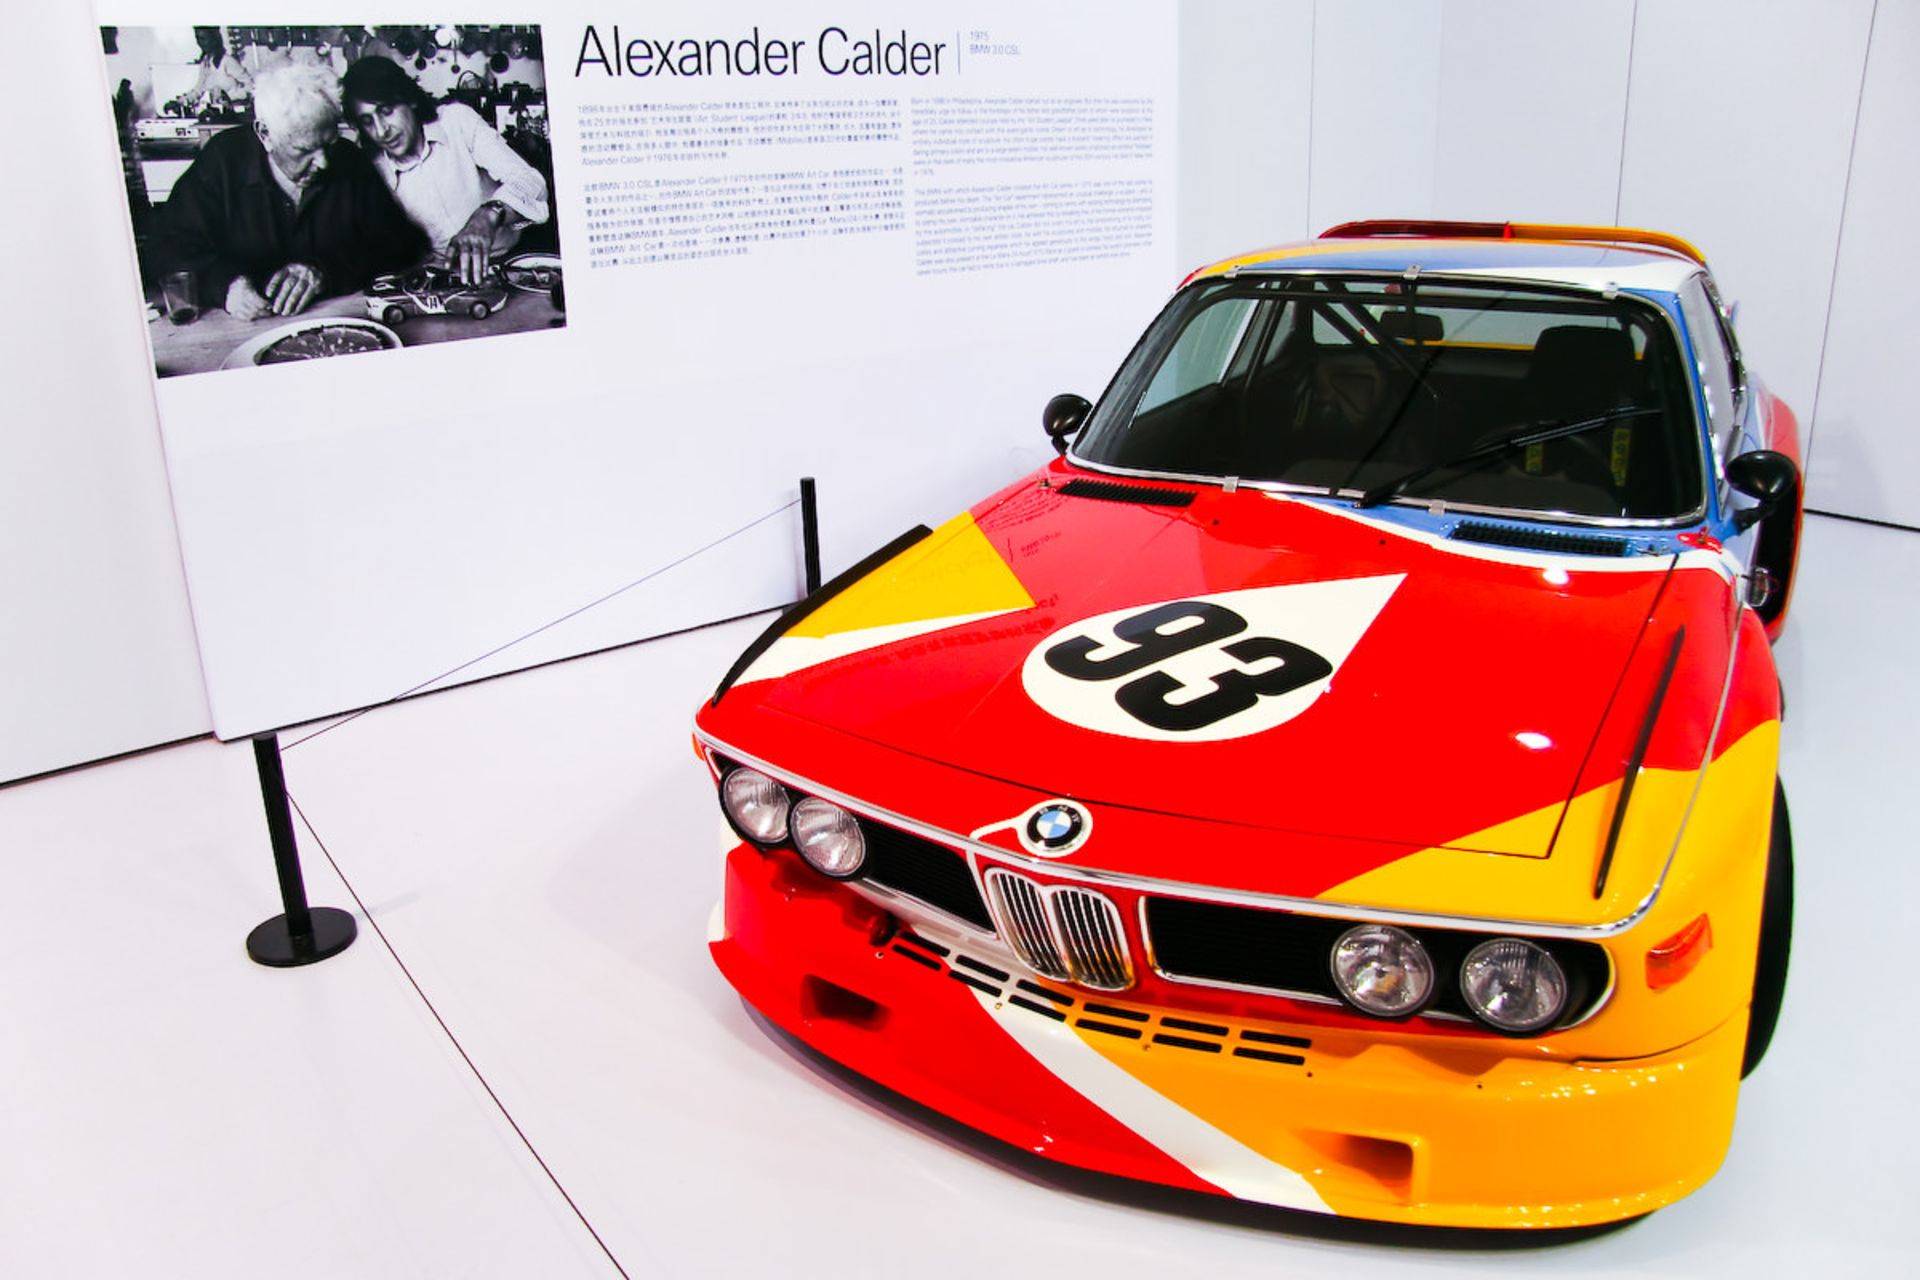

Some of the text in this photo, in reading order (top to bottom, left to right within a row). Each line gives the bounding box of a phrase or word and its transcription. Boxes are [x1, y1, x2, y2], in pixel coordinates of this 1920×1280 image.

[575, 25, 947, 77] Alexander Calder
[969, 31, 990, 41] 1975
[969, 43, 991, 55] BMW
[1044, 600, 1333, 732] 93
